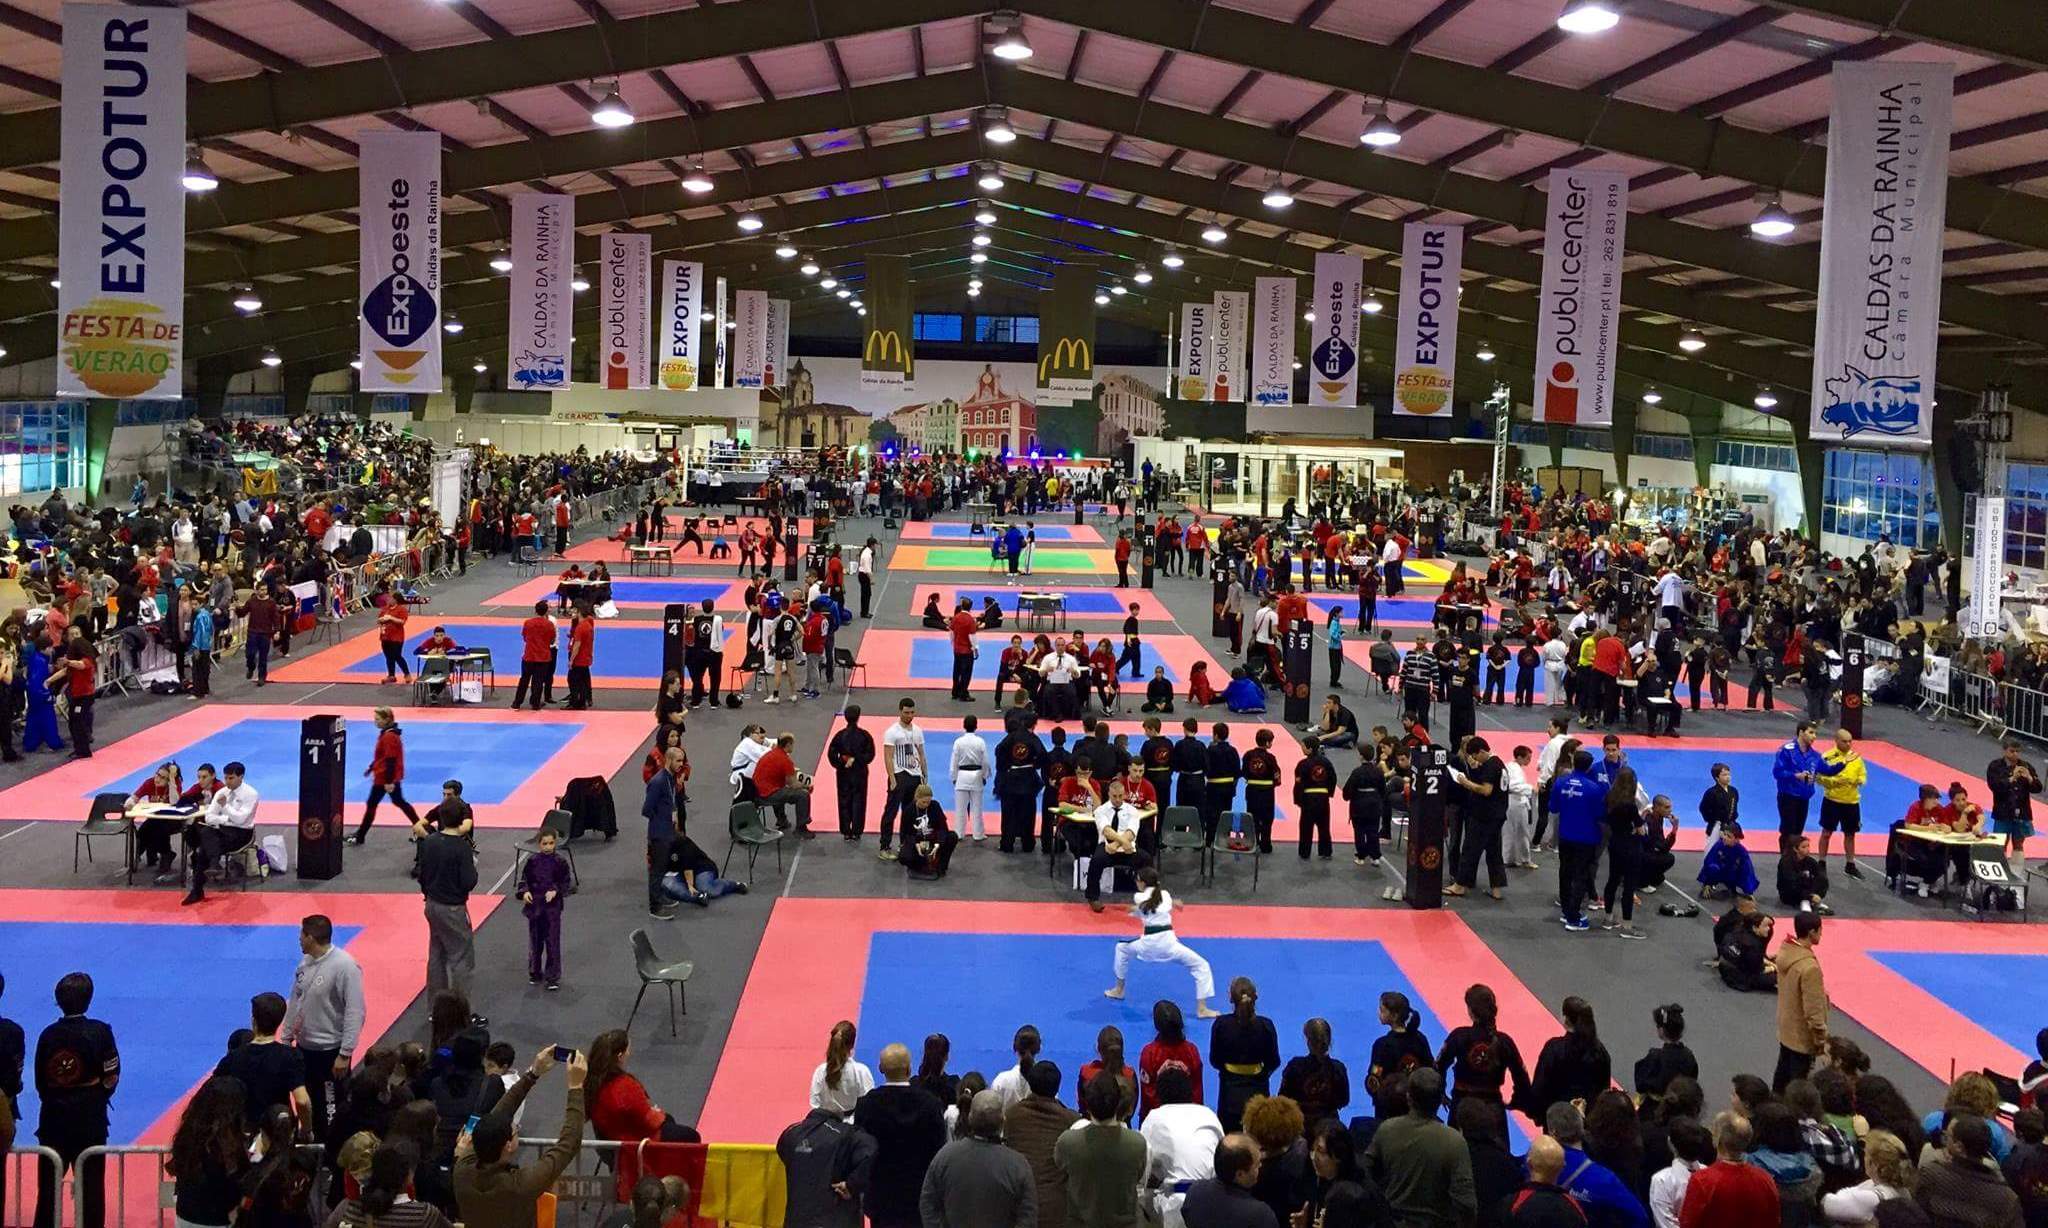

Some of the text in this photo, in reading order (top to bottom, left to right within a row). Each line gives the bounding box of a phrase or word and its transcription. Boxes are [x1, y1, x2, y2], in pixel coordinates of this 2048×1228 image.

[101, 18, 149, 293] EXPOTUR
[1607, 184, 1618, 208] 819
[1605, 211, 1616, 235] 831
[1864, 83, 1903, 361] CALDAS DA RAINHA
[1891, 82, 1925, 361] Câmara Municipal
[427, 180, 438, 290] Caldas da Rainha
[387, 178, 415, 335] Expoeste
[1603, 238, 1615, 261] 262
[534, 204, 550, 348] CALDAS DA RAINHA
[1551, 177, 1587, 356] publicenter
[608, 238, 628, 348] publicenter
[1415, 230, 1446, 365] EXPOTUR
[673, 265, 691, 357] EXPOTUR
[63, 314, 180, 341] FESTA DE
[1269, 284, 1280, 380] CALDAS DA RAINHA
[1326, 281, 1344, 374] Expoeste
[1189, 307, 1204, 376] EXPOTUR
[660, 362, 687, 373] FESTA
[1397, 373, 1452, 389] FESTA DE
[787, 527, 798, 536] 10
[1217, 572, 1224, 582] 8
[1622, 584, 1629, 594] 9
[668, 623, 679, 636] 4
[1300, 637, 1309, 650] 5
[1849, 653, 1859, 666] 6
[308, 746, 319, 764] 1
[334, 744, 341, 762] 1
[1426, 776, 1439, 794] 2
[1978, 863, 2003, 878] 80
